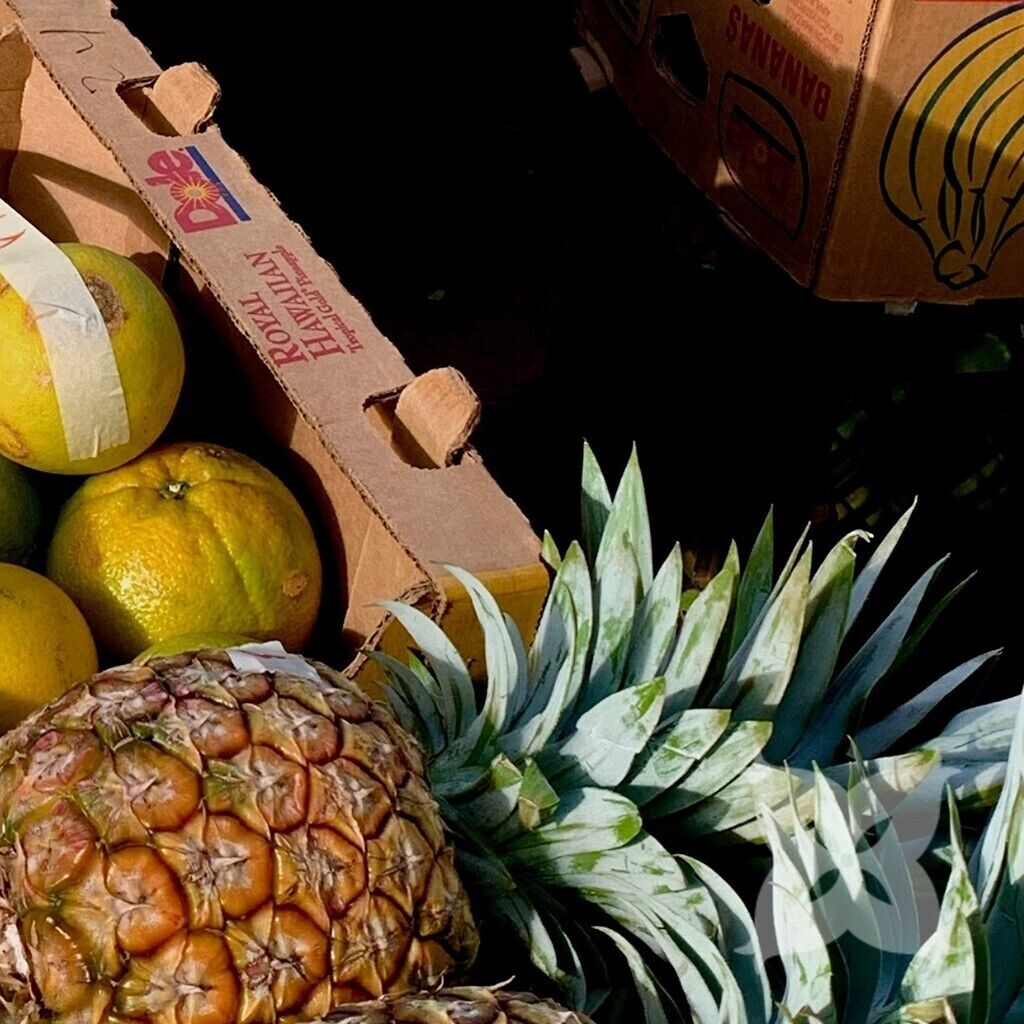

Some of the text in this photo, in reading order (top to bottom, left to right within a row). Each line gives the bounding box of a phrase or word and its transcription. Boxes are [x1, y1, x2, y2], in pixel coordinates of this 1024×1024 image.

[726, 3, 832, 122] BANANAS
[144, 146, 239, 234] Dole
[238, 291, 309, 368] ROYAL
[243, 251, 346, 360] HAWAIIAN
